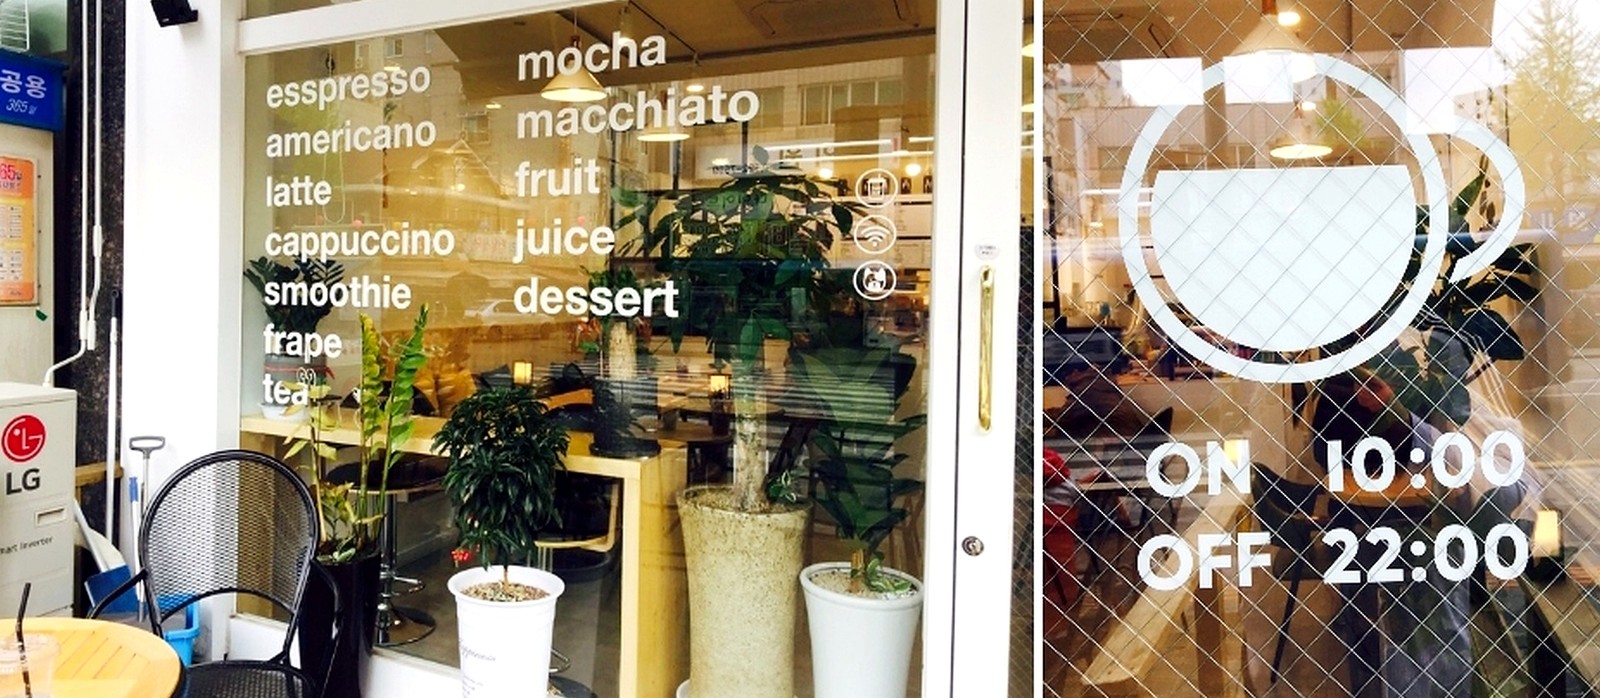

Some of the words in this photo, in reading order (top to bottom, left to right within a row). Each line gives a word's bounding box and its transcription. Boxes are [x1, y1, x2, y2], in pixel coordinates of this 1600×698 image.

[518, 31, 667, 81] mocha
[0, 69, 47, 99] 공용
[266, 66, 431, 110] esspresso
[517, 84, 760, 139] macchiato
[266, 120, 436, 158] americano
[266, 176, 332, 207] latte
[515, 157, 600, 198] fruit
[264, 222, 455, 263] cappuccino
[512, 217, 616, 264] juice
[264, 275, 412, 310] smoothie
[513, 277, 679, 319] dessert
[263, 323, 342, 364] frape
[262, 373, 309, 405] tea
[6, 468, 40, 495] LG
[1146, 439, 1251, 498] ON
[1327, 430, 1525, 493] 10:00
[1137, 532, 1272, 591] OFF
[1322, 523, 1529, 584] 22:00
